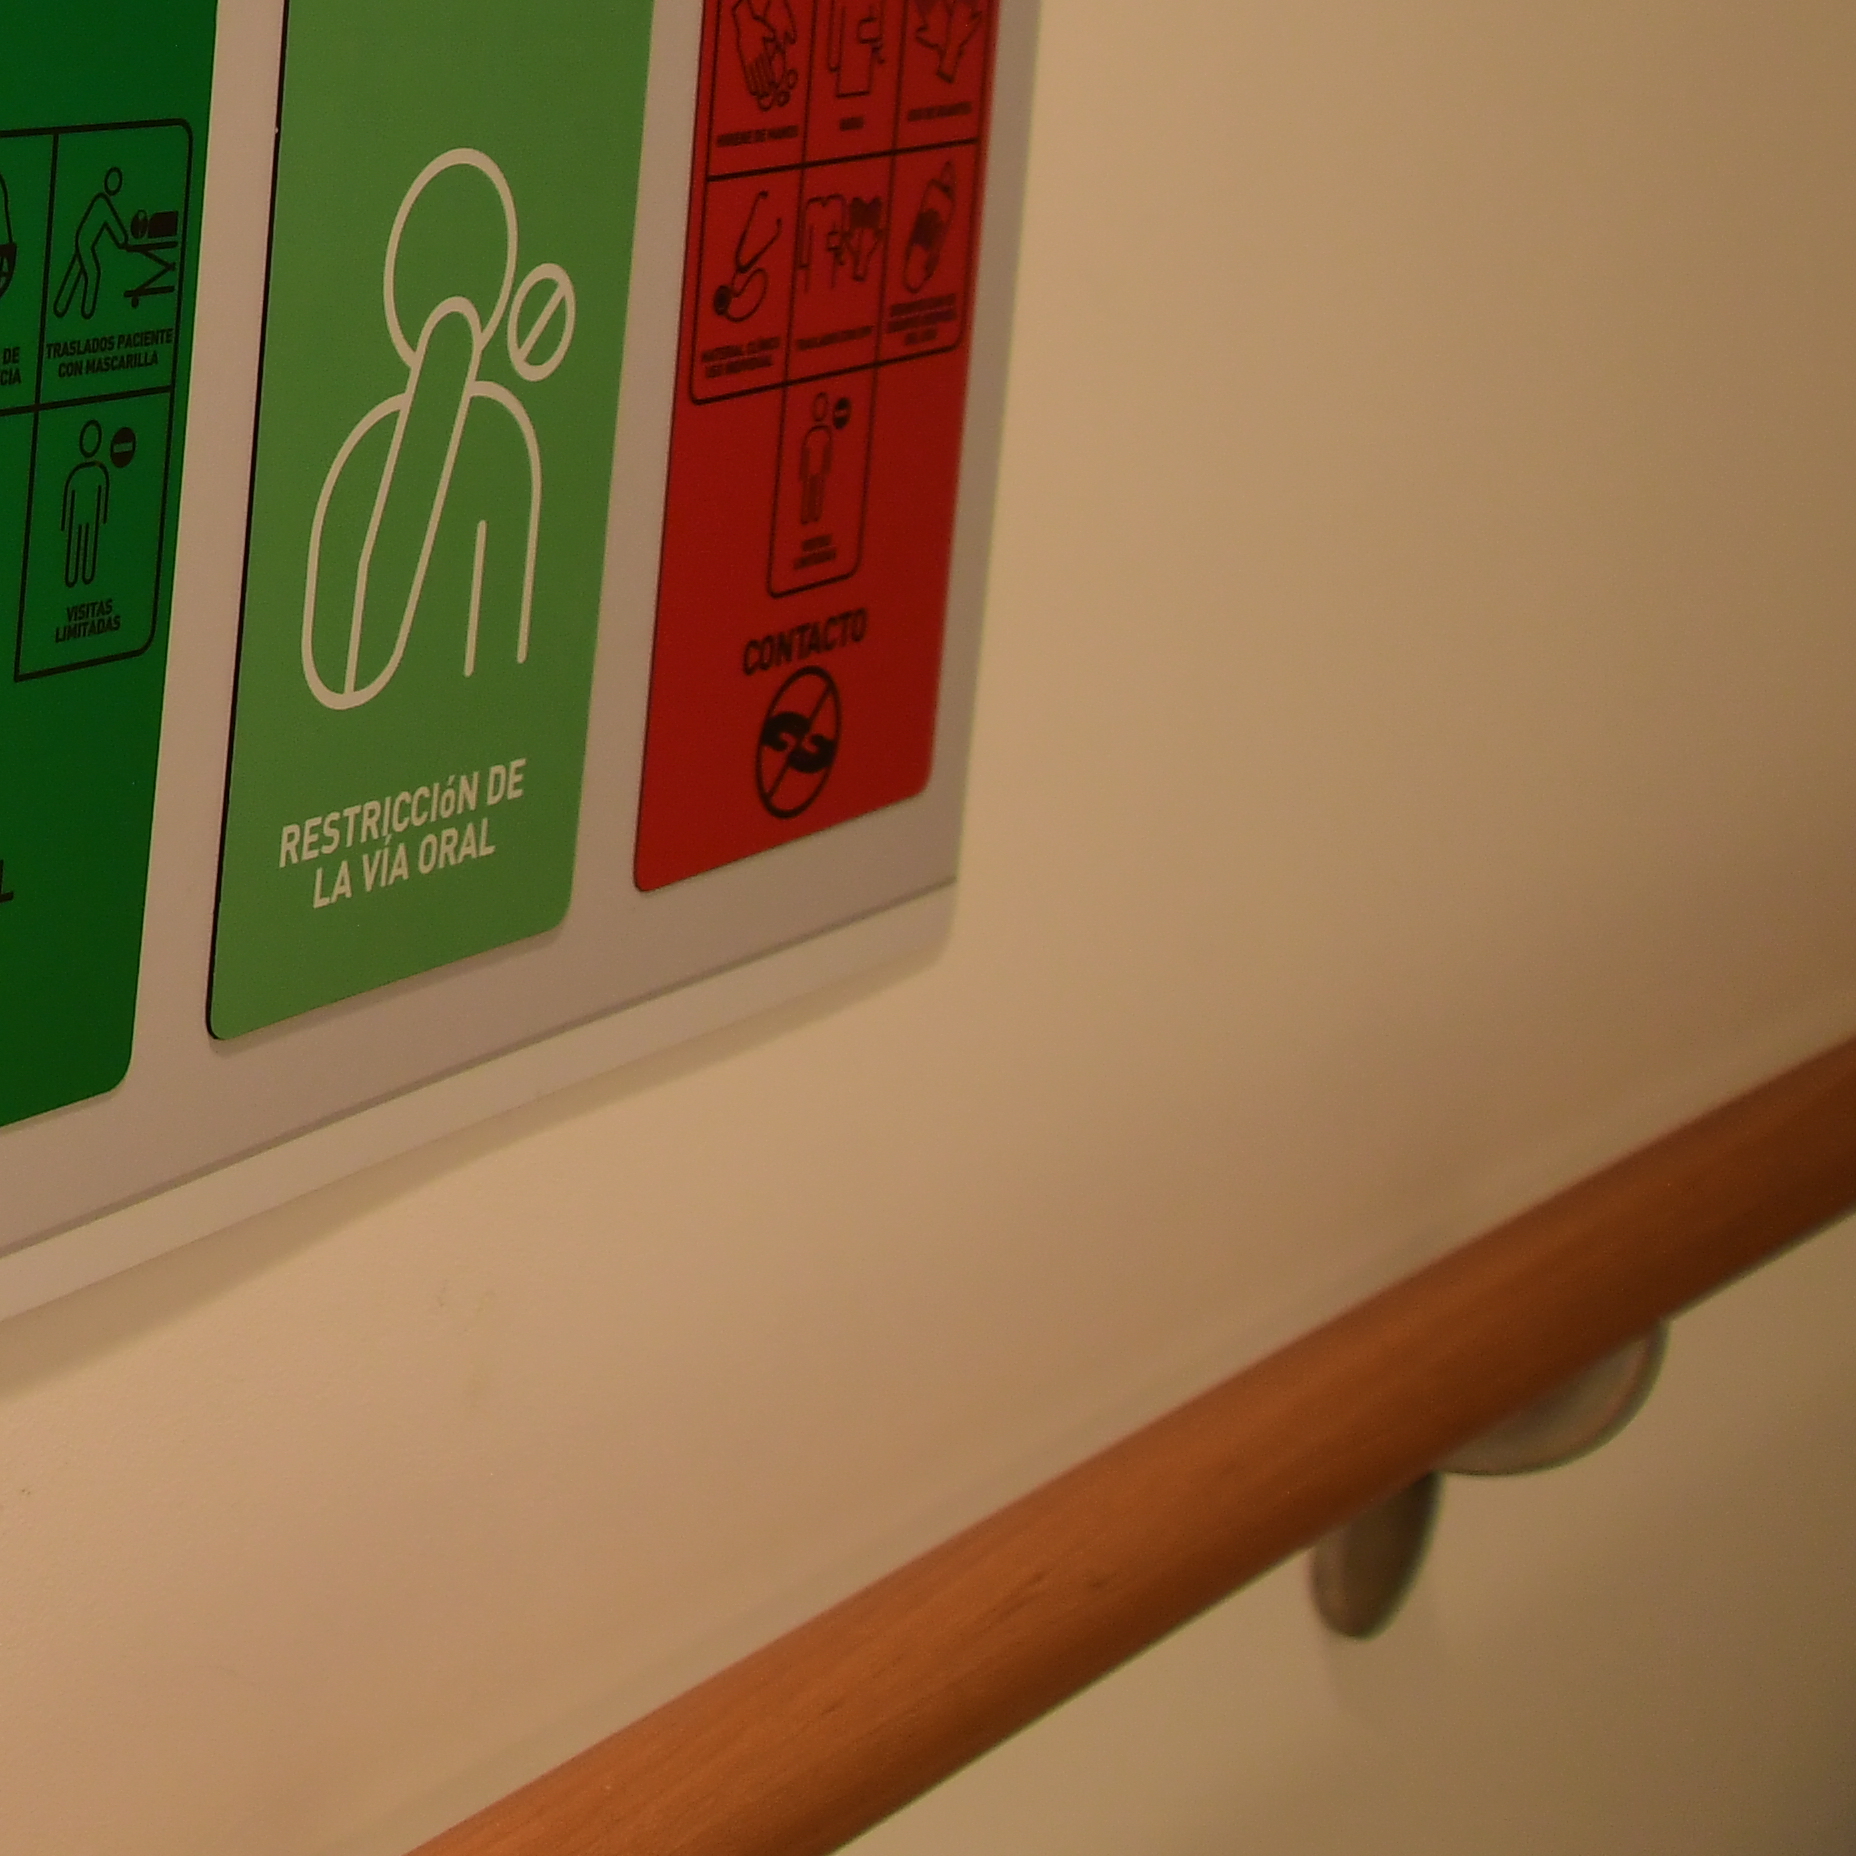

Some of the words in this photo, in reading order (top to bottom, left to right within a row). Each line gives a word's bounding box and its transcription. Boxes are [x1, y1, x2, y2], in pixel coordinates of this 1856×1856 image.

[3, 346, 20, 365] DE
[46, 335, 115, 359] TRASLADOS
[117, 328, 174, 350] PACIENTE
[58, 360, 83, 378] CON
[86, 350, 158, 374] MASCARILLA
[67, 598, 113, 622] VISITAS
[55, 615, 121, 643] LIMITADAS
[743, 608, 866, 675] CONTACTO
[488, 758, 526, 806] DE
[312, 860, 352, 909] LA
[418, 818, 496, 875] ORAL
